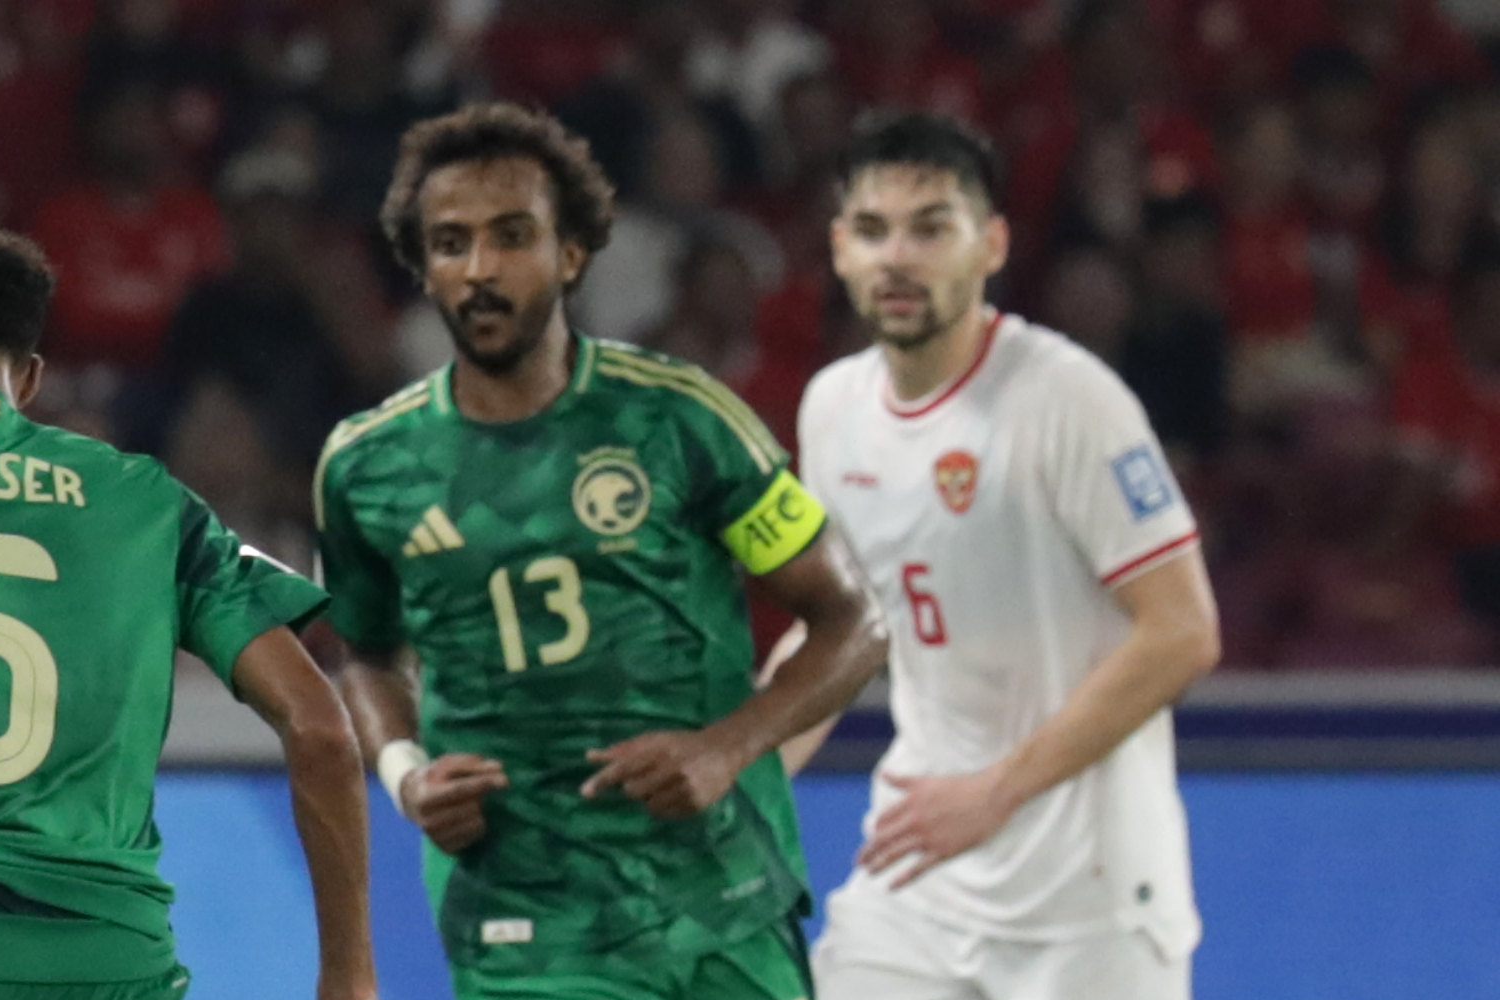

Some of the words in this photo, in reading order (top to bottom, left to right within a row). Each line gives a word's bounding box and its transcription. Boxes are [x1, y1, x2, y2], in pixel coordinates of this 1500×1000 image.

[743, 488, 805, 557] AFC
[488, 555, 590, 673] 13
[901, 563, 949, 646] 6
